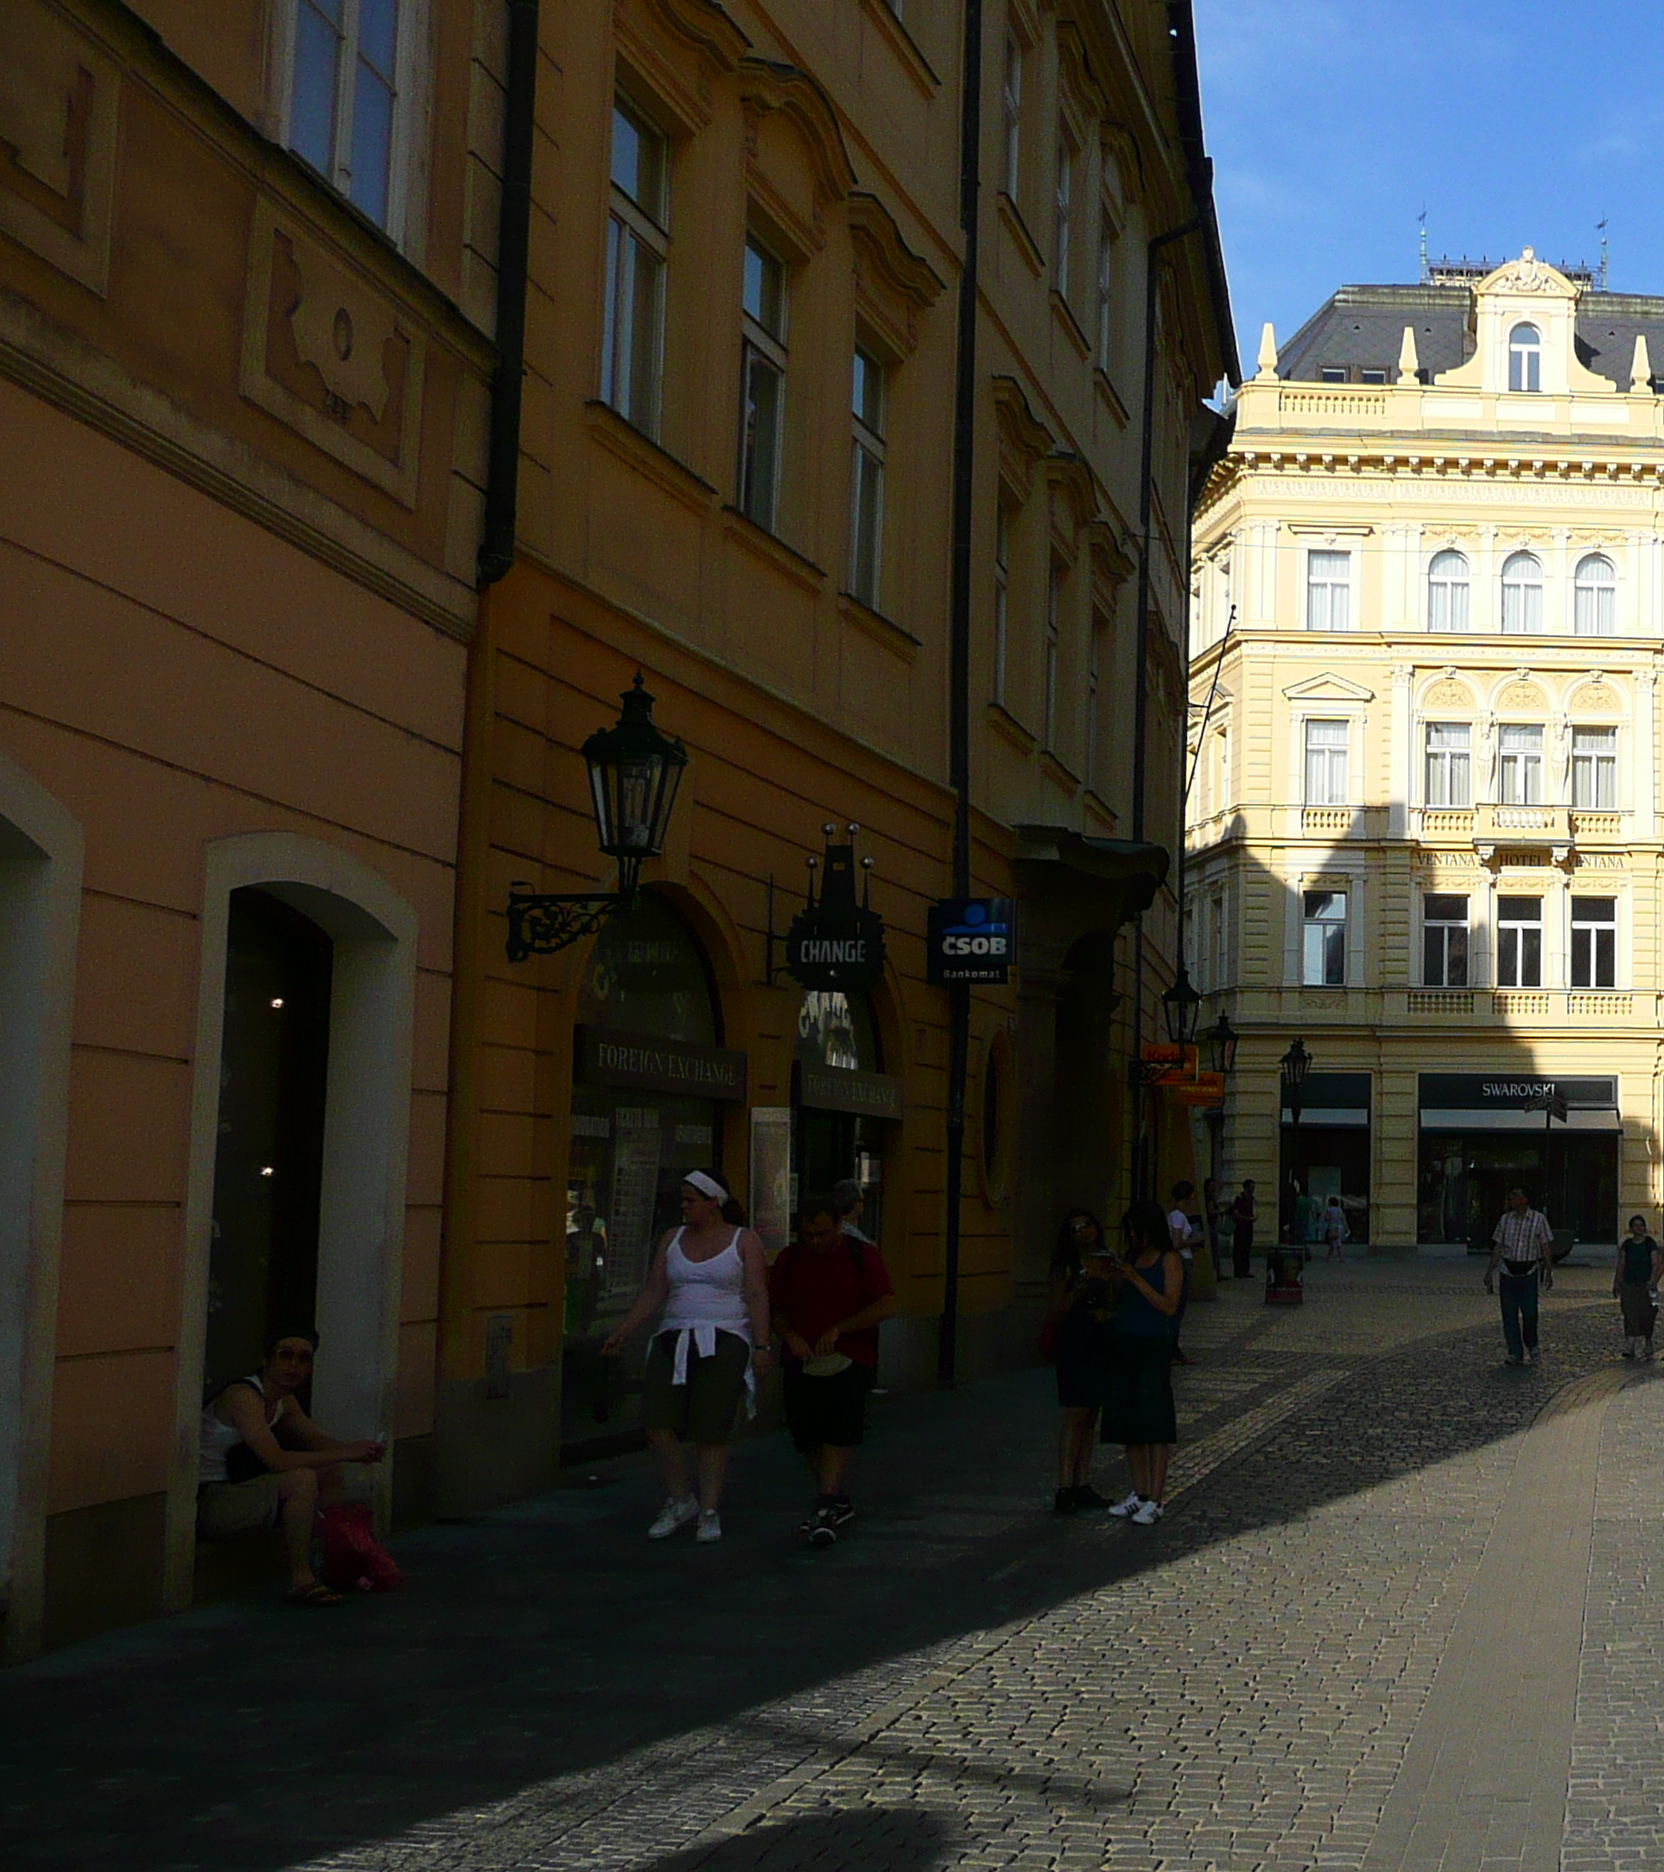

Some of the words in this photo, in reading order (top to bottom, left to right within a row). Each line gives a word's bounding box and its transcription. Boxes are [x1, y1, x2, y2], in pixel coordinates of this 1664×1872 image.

[1417, 852, 1477, 867] VENTANA
[1498, 853, 1545, 867] HOTEL
[1567, 854, 1625, 868] VENTANA
[800, 939, 866, 963] CHANGE
[941, 935, 1008, 956] ČSOB
[943, 968, 1001, 980] Bankomat
[598, 1043, 665, 1075] FOREIGN
[667, 1054, 737, 1087] EXCHANGE
[1481, 1082, 1556, 1097] SWAROVSKI
